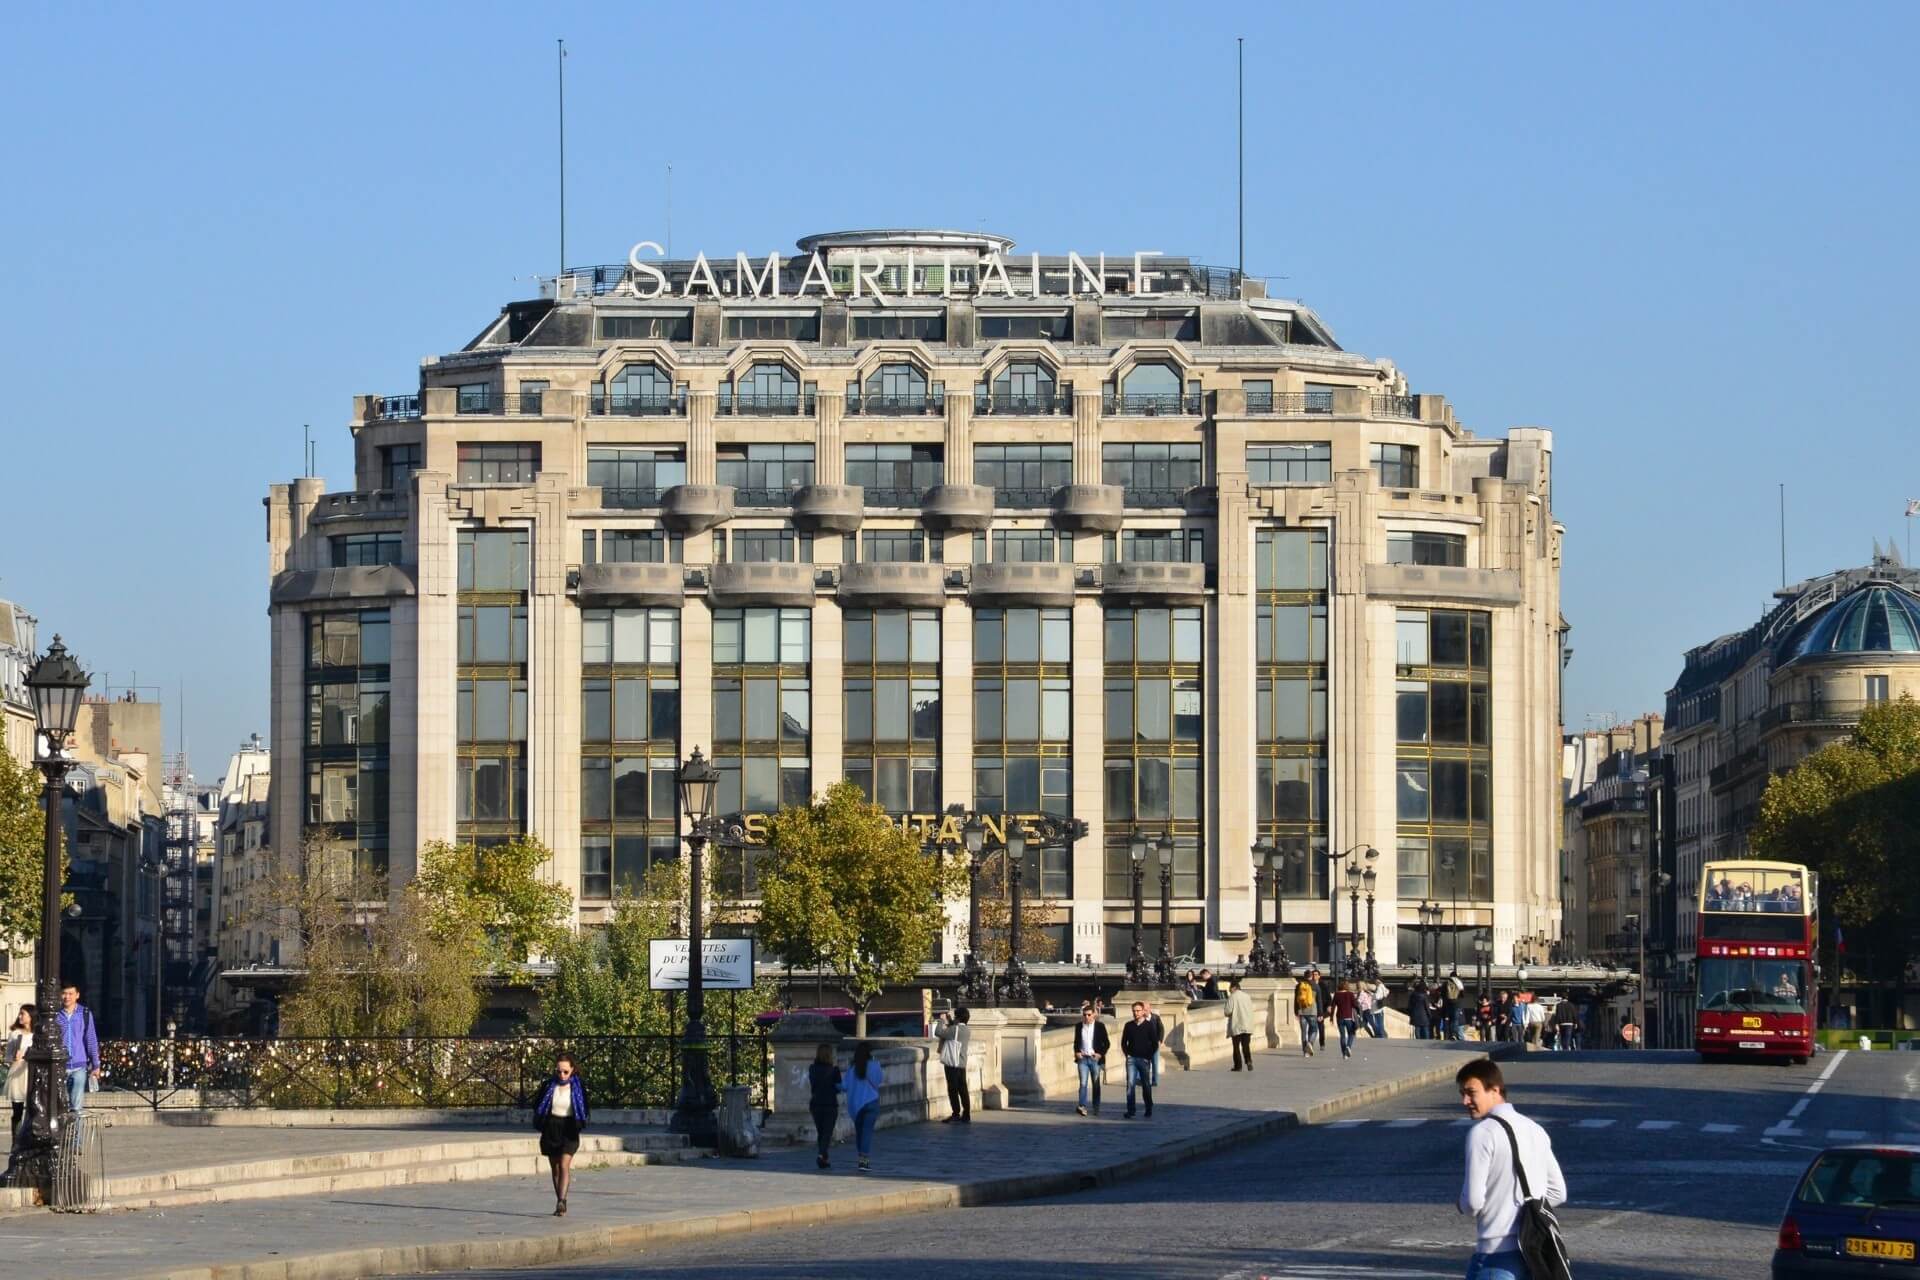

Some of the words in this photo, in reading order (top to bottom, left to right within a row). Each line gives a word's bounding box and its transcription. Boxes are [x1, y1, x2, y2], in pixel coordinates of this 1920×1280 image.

[629, 241, 1163, 306] SAMARITAINE
[675, 943, 728, 953] VETTES
[663, 954, 678, 964] DU
[680, 954, 709, 964] PT
[711, 954, 741, 964] NEUF
[1847, 1239, 1868, 1253] 296
[1898, 1243, 1913, 1257] 75
